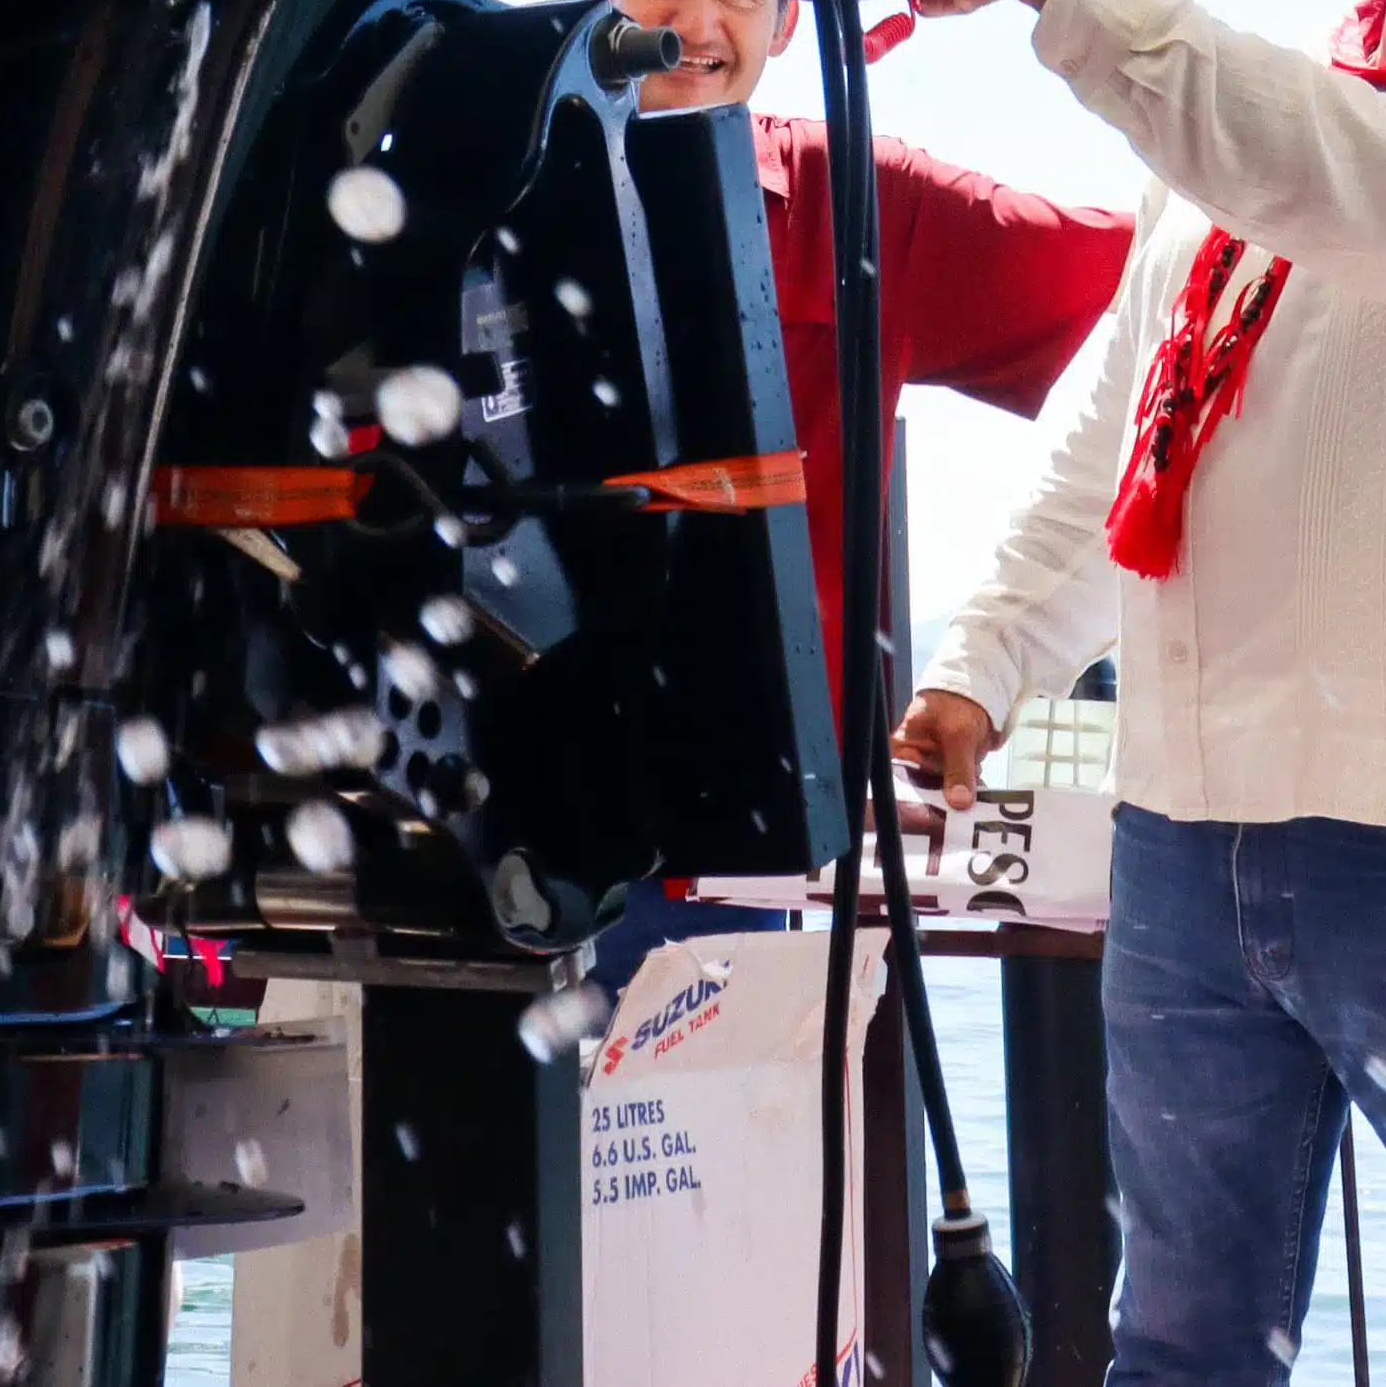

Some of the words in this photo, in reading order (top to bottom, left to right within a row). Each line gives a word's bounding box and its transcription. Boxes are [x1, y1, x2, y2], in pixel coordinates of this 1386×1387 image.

[654, 1028, 685, 1060] FUEL
[688, 1001, 721, 1034] TANK
[592, 1105, 611, 1133] 25
[616, 1098, 665, 1129] LITRES
[592, 1140, 618, 1168] 6.6
[623, 1135, 657, 1164] U.S.
[661, 1131, 697, 1157] GAL.
[592, 1176, 619, 1205] 5.5
[625, 1171, 661, 1200] IMP.
[666, 1165, 702, 1193] GAL.
